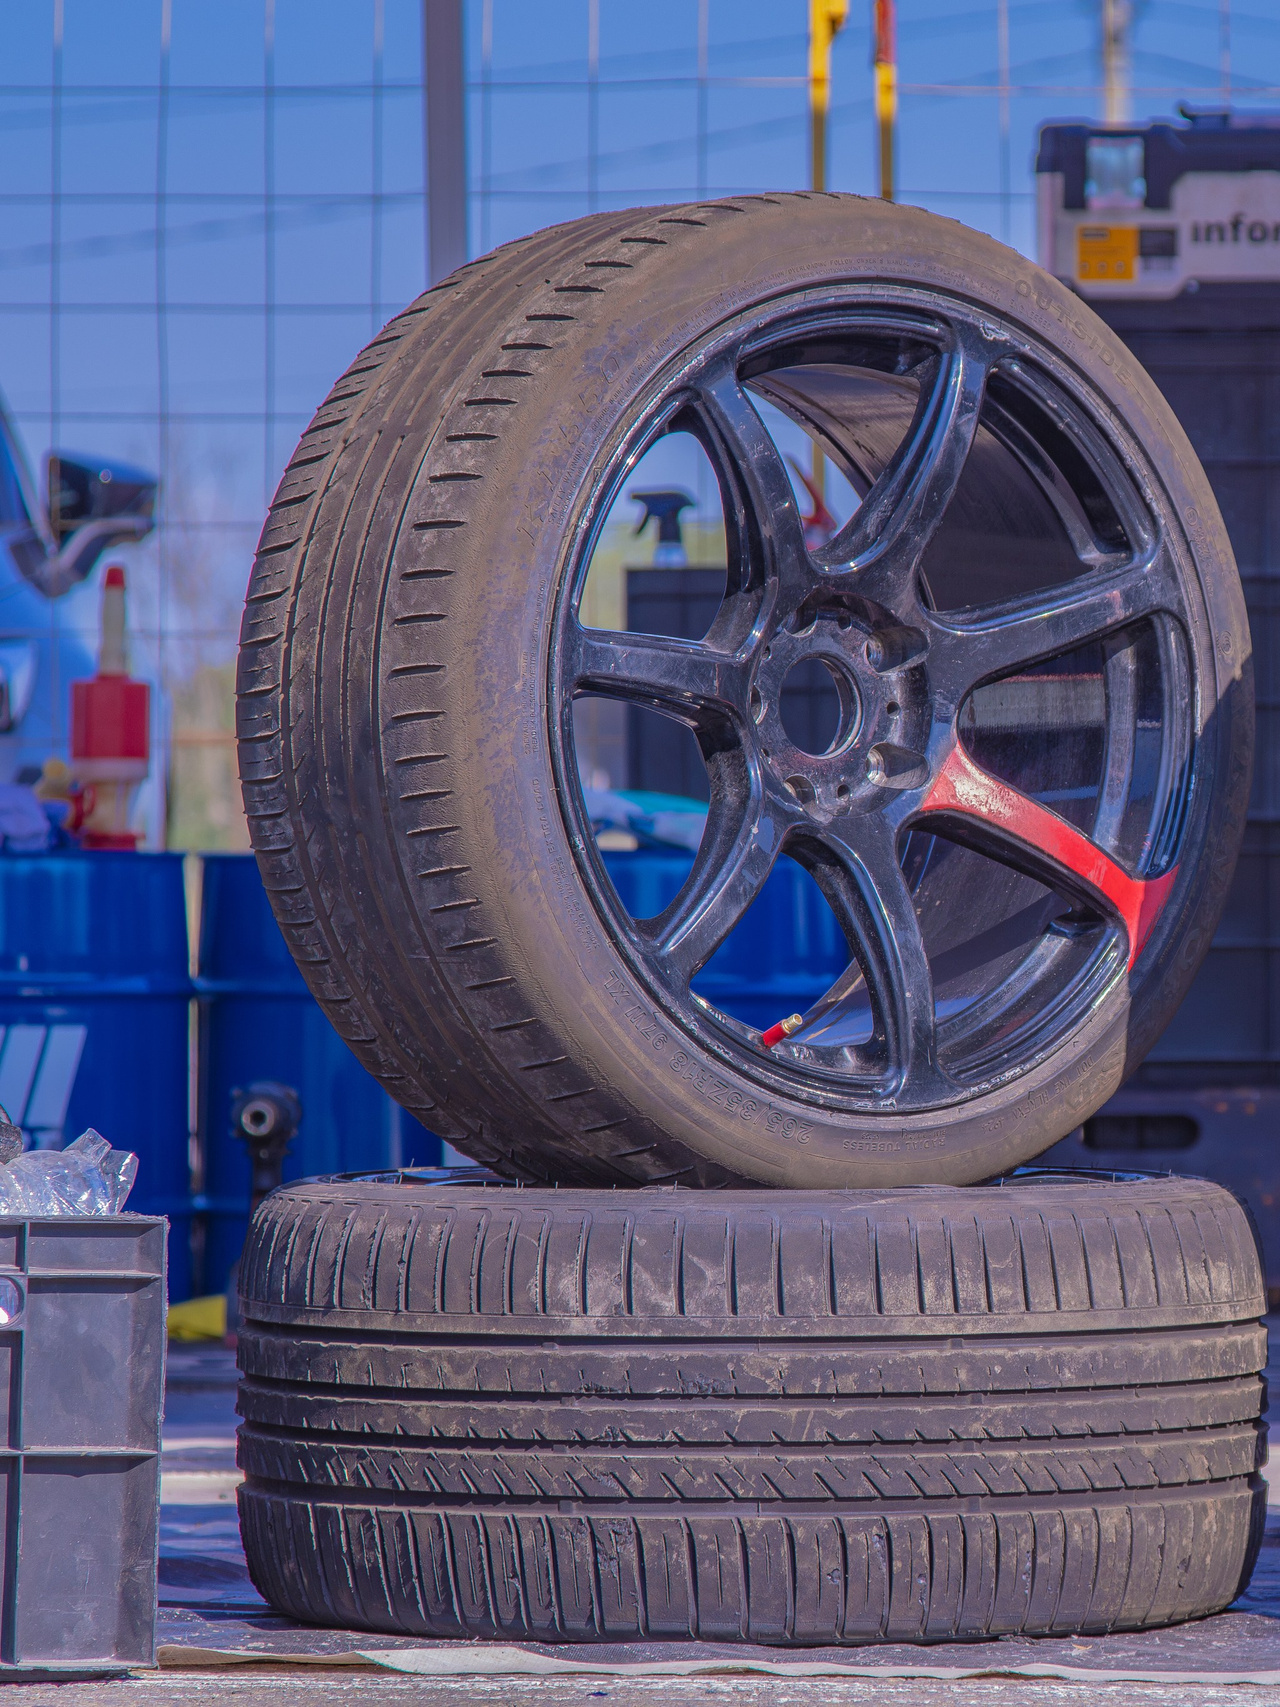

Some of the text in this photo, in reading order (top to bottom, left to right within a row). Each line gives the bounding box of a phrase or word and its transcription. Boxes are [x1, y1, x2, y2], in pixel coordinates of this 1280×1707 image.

[1012, 276, 1133, 386] OUTSIDE
[599, 966, 814, 1152] 265/35ZR18 97W XL
[1073, 1053, 1095, 1078] DOT
[842, 1135, 900, 1154] TUBELESS
[904, 1135, 946, 1150] RADIAL
